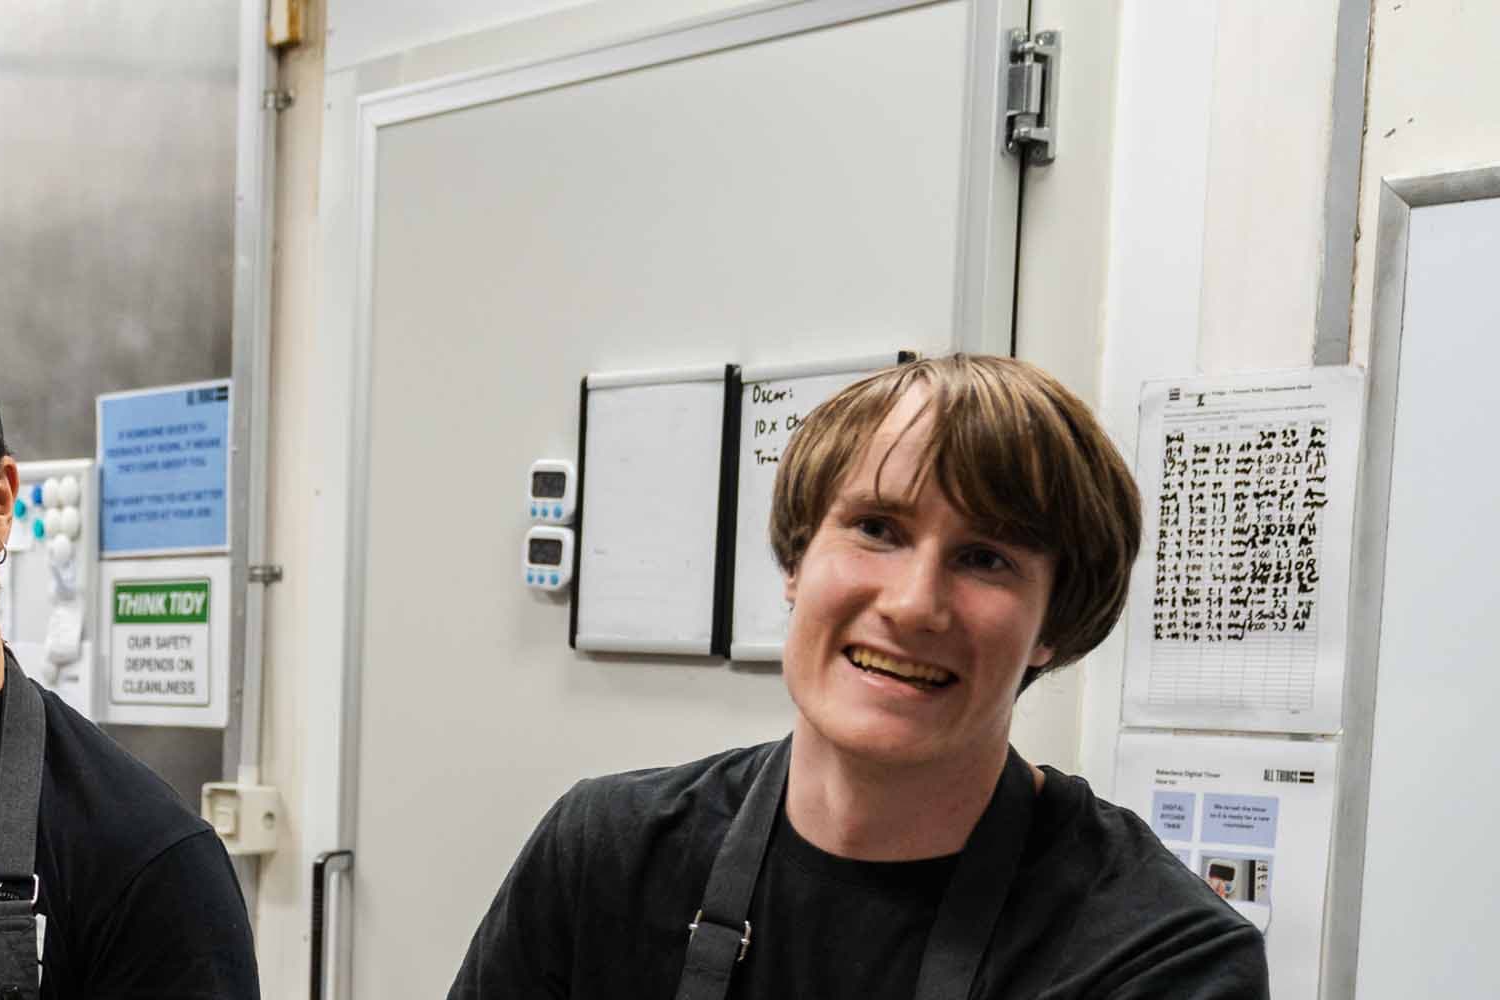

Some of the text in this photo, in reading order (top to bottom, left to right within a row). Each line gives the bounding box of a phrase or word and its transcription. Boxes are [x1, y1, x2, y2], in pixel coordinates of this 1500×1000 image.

[752, 384, 793, 404] Oscar:
[786, 413, 805, 431] Ch
[117, 591, 206, 616] THINK TIDY
[127, 635, 191, 650] OUR SAFETY
[124, 657, 194, 672] DEPENDS ON
[122, 679, 195, 695] CLEANLINESS
[1264, 769, 1274, 782] ALL
